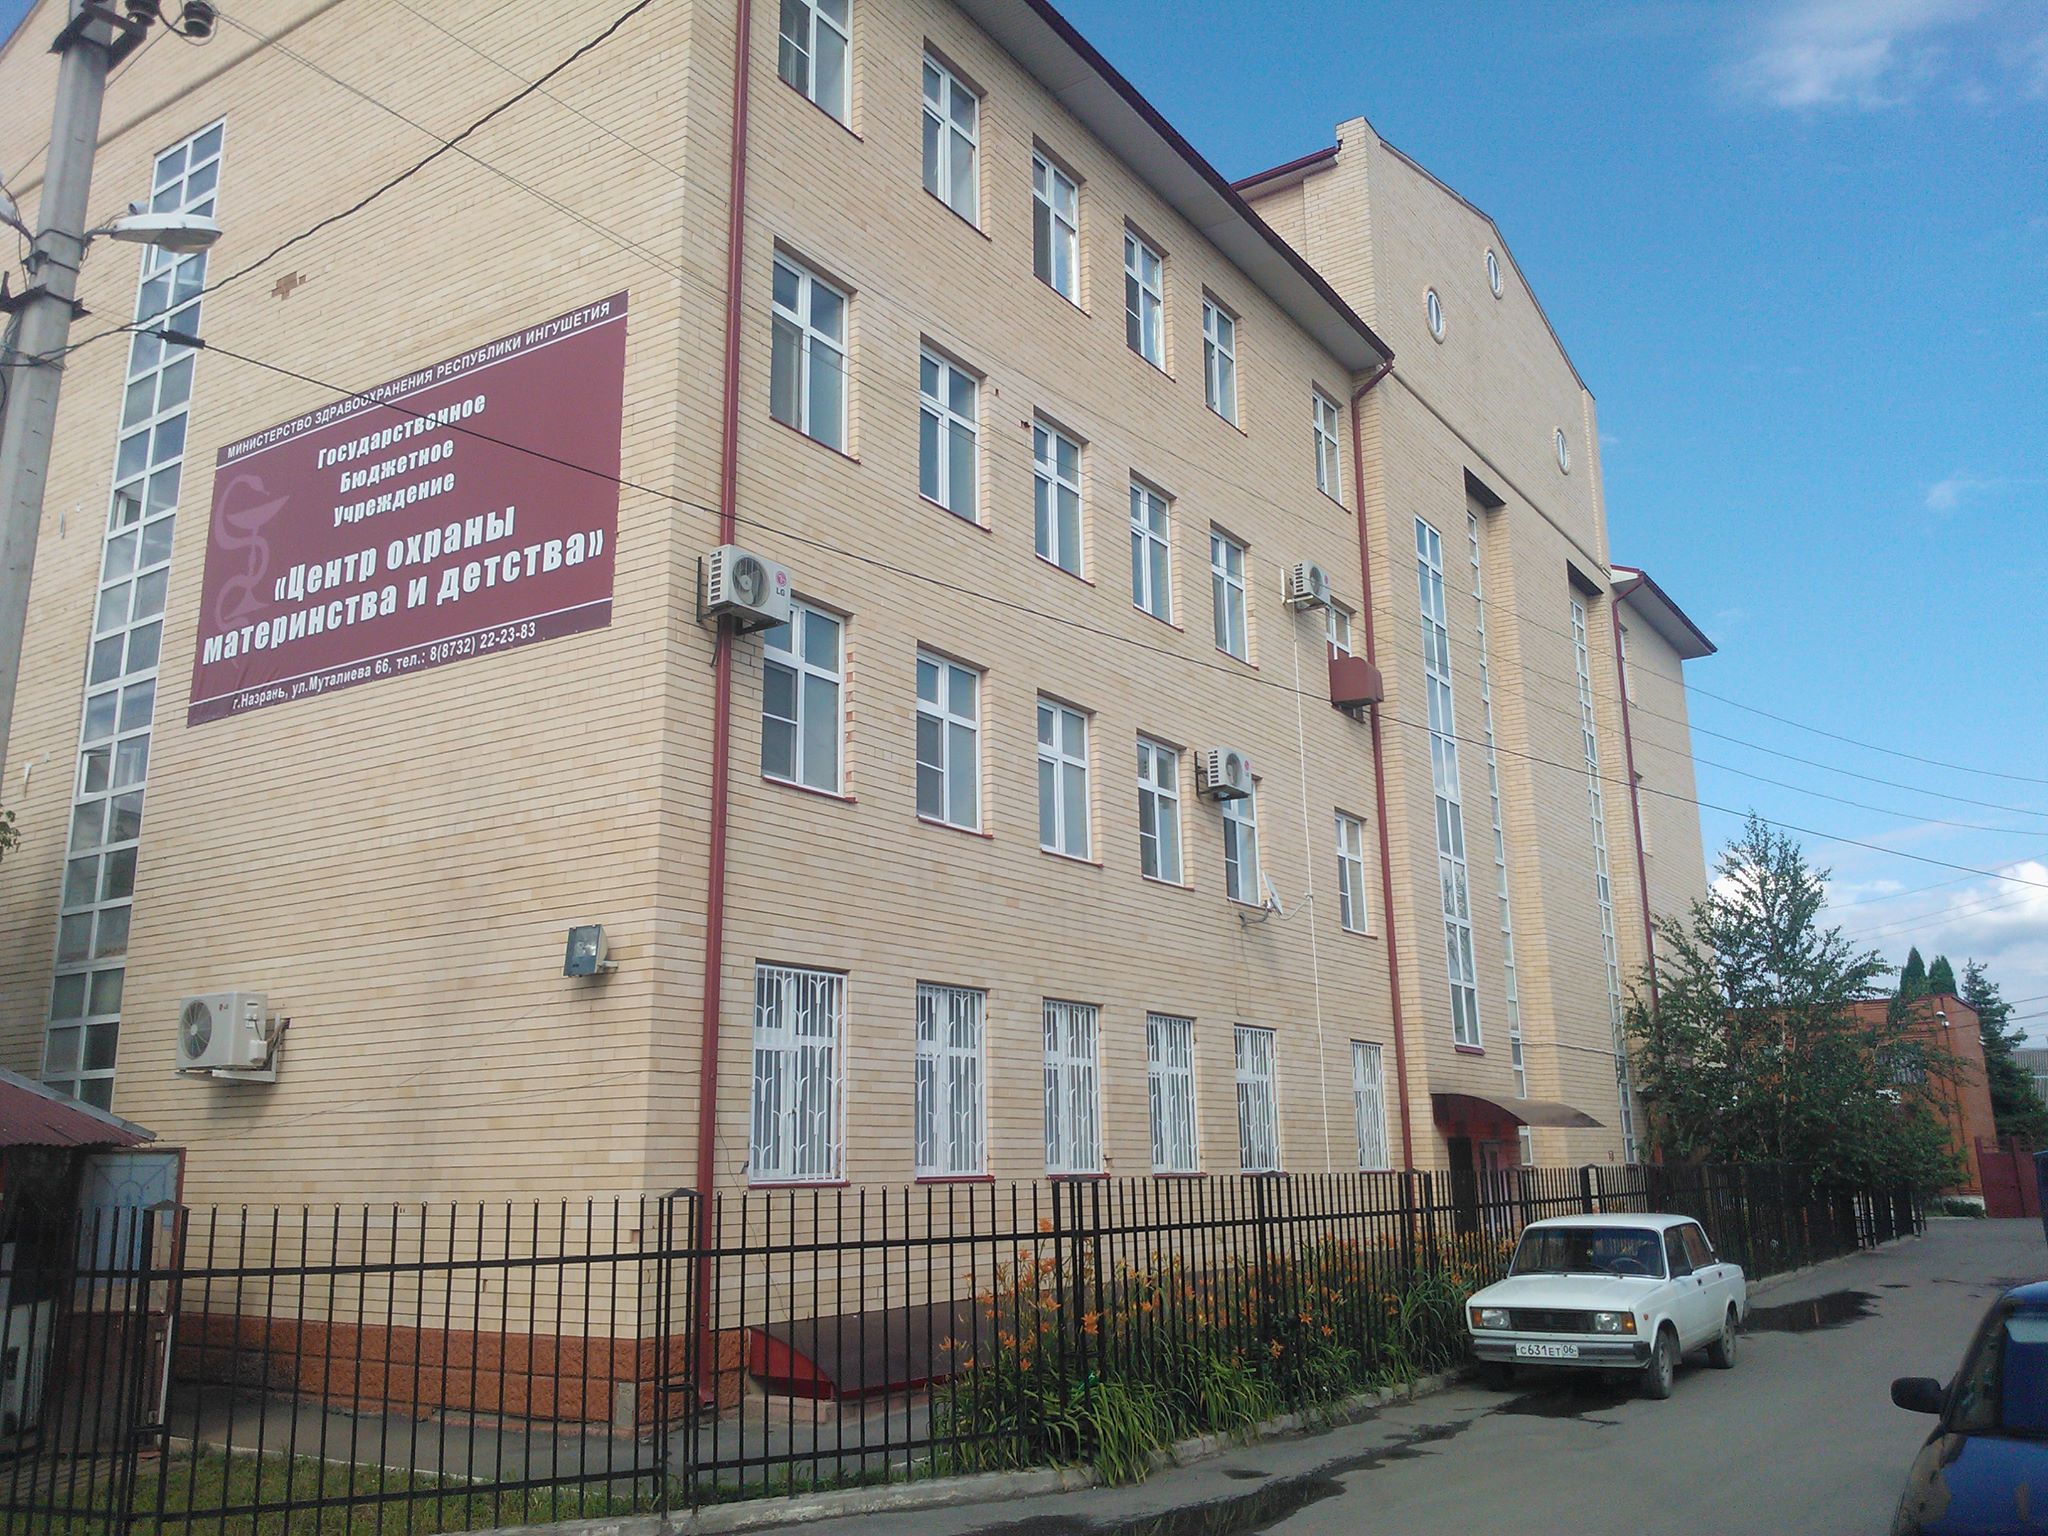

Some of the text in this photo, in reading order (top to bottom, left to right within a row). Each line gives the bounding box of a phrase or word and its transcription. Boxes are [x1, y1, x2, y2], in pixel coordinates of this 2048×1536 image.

[227, 301, 610, 459] МИНИСТЕРСТВО ЗДРАВООХРАНЕНИЯ РЕСПУБЛИКИ ИНГУШЕТИЯ
[317, 394, 486, 469] Государственное
[340, 439, 454, 493] Бюджетное
[333, 472, 456, 528] Учреждение
[274, 505, 515, 602] «Центр охраны
[776, 587, 785, 596] LG
[202, 528, 604, 665] материнства и детства»
[232, 686, 288, 710] г.Назрань,
[375, 657, 392, 674] 66,
[396, 652, 426, 669] тел.:
[429, 636, 476, 663] 8(8732)
[479, 621, 536, 649] 22-23-83
